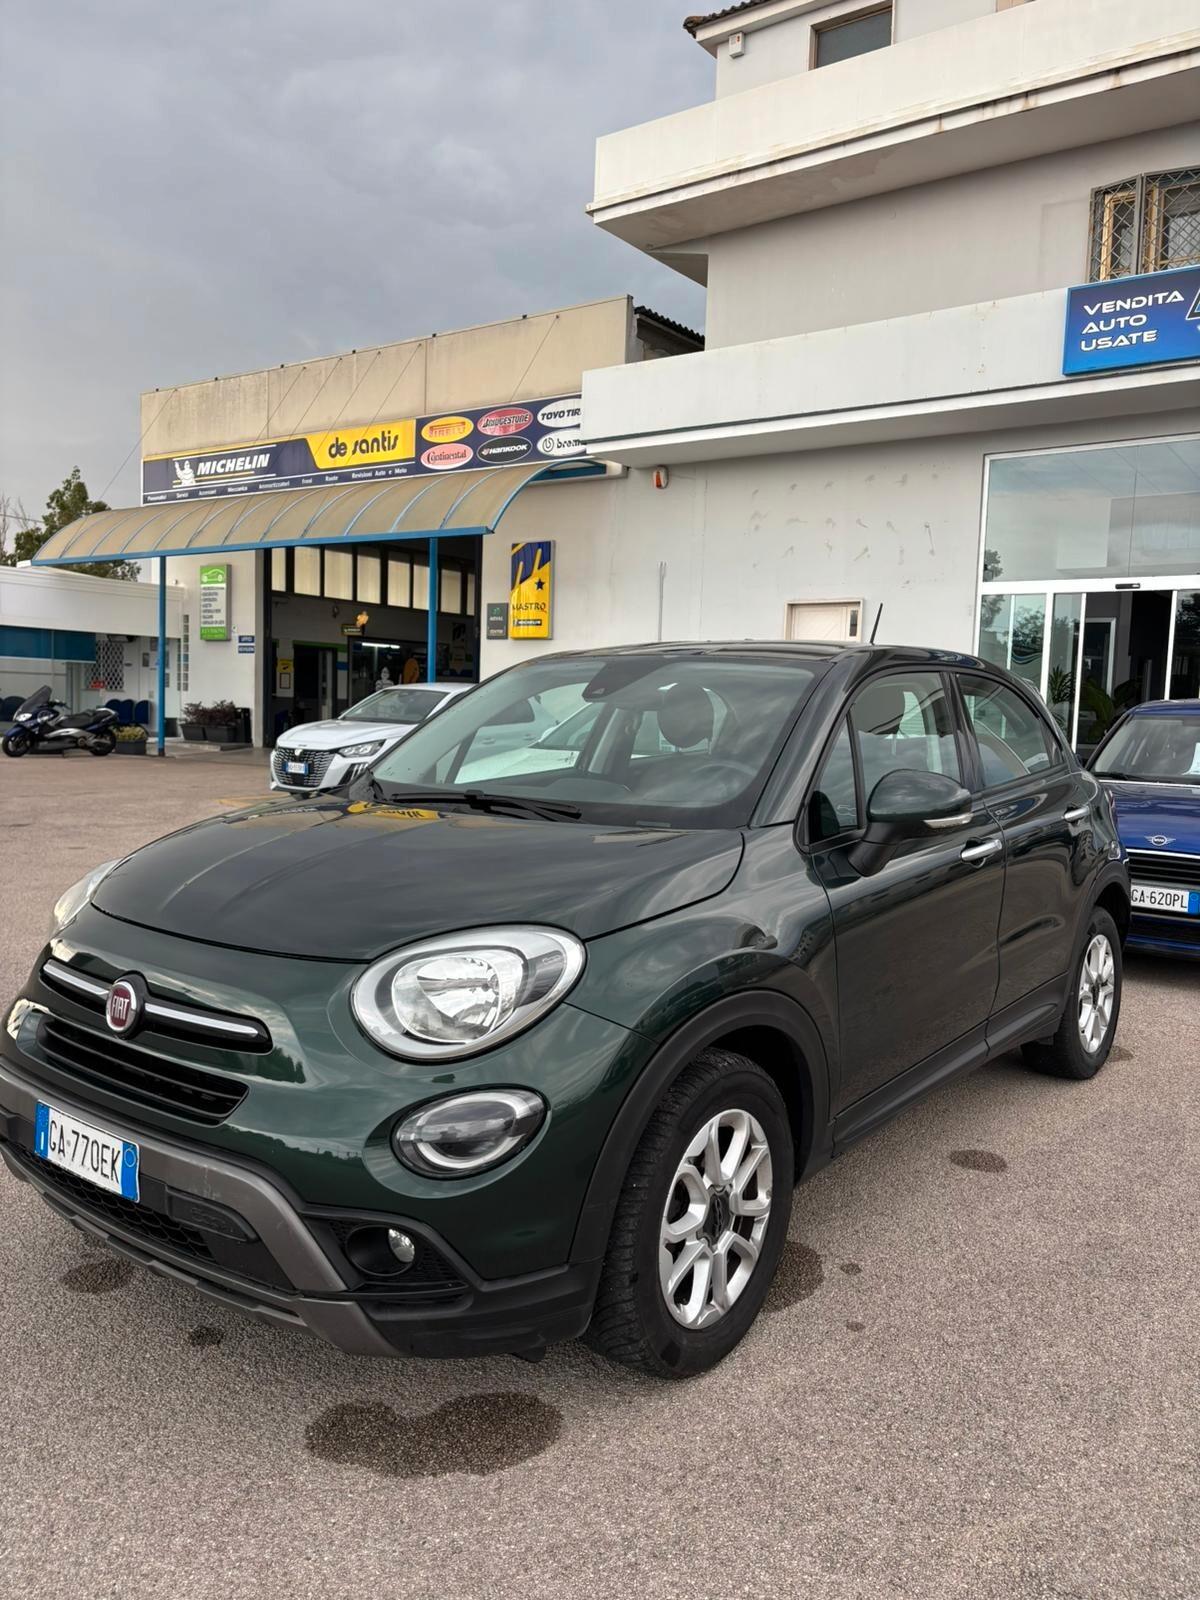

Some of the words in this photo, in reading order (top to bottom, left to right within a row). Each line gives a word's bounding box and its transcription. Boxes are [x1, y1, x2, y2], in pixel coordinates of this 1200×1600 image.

[1083, 290, 1184, 315] VENDITA
[1081, 314, 1147, 334] AUTO
[1080, 329, 1158, 351] USATE
[482, 414, 529, 428] BRIDGESTONE
[541, 409, 566, 420] TOYO
[328, 437, 347, 459] de
[352, 430, 399, 455] santis
[196, 453, 271, 476] MICHELIN
[427, 449, 467, 465] Continental
[374, 469, 386, 477] Auto
[394, 466, 408, 474] Moto
[111, 995, 130, 1021] FIAT
